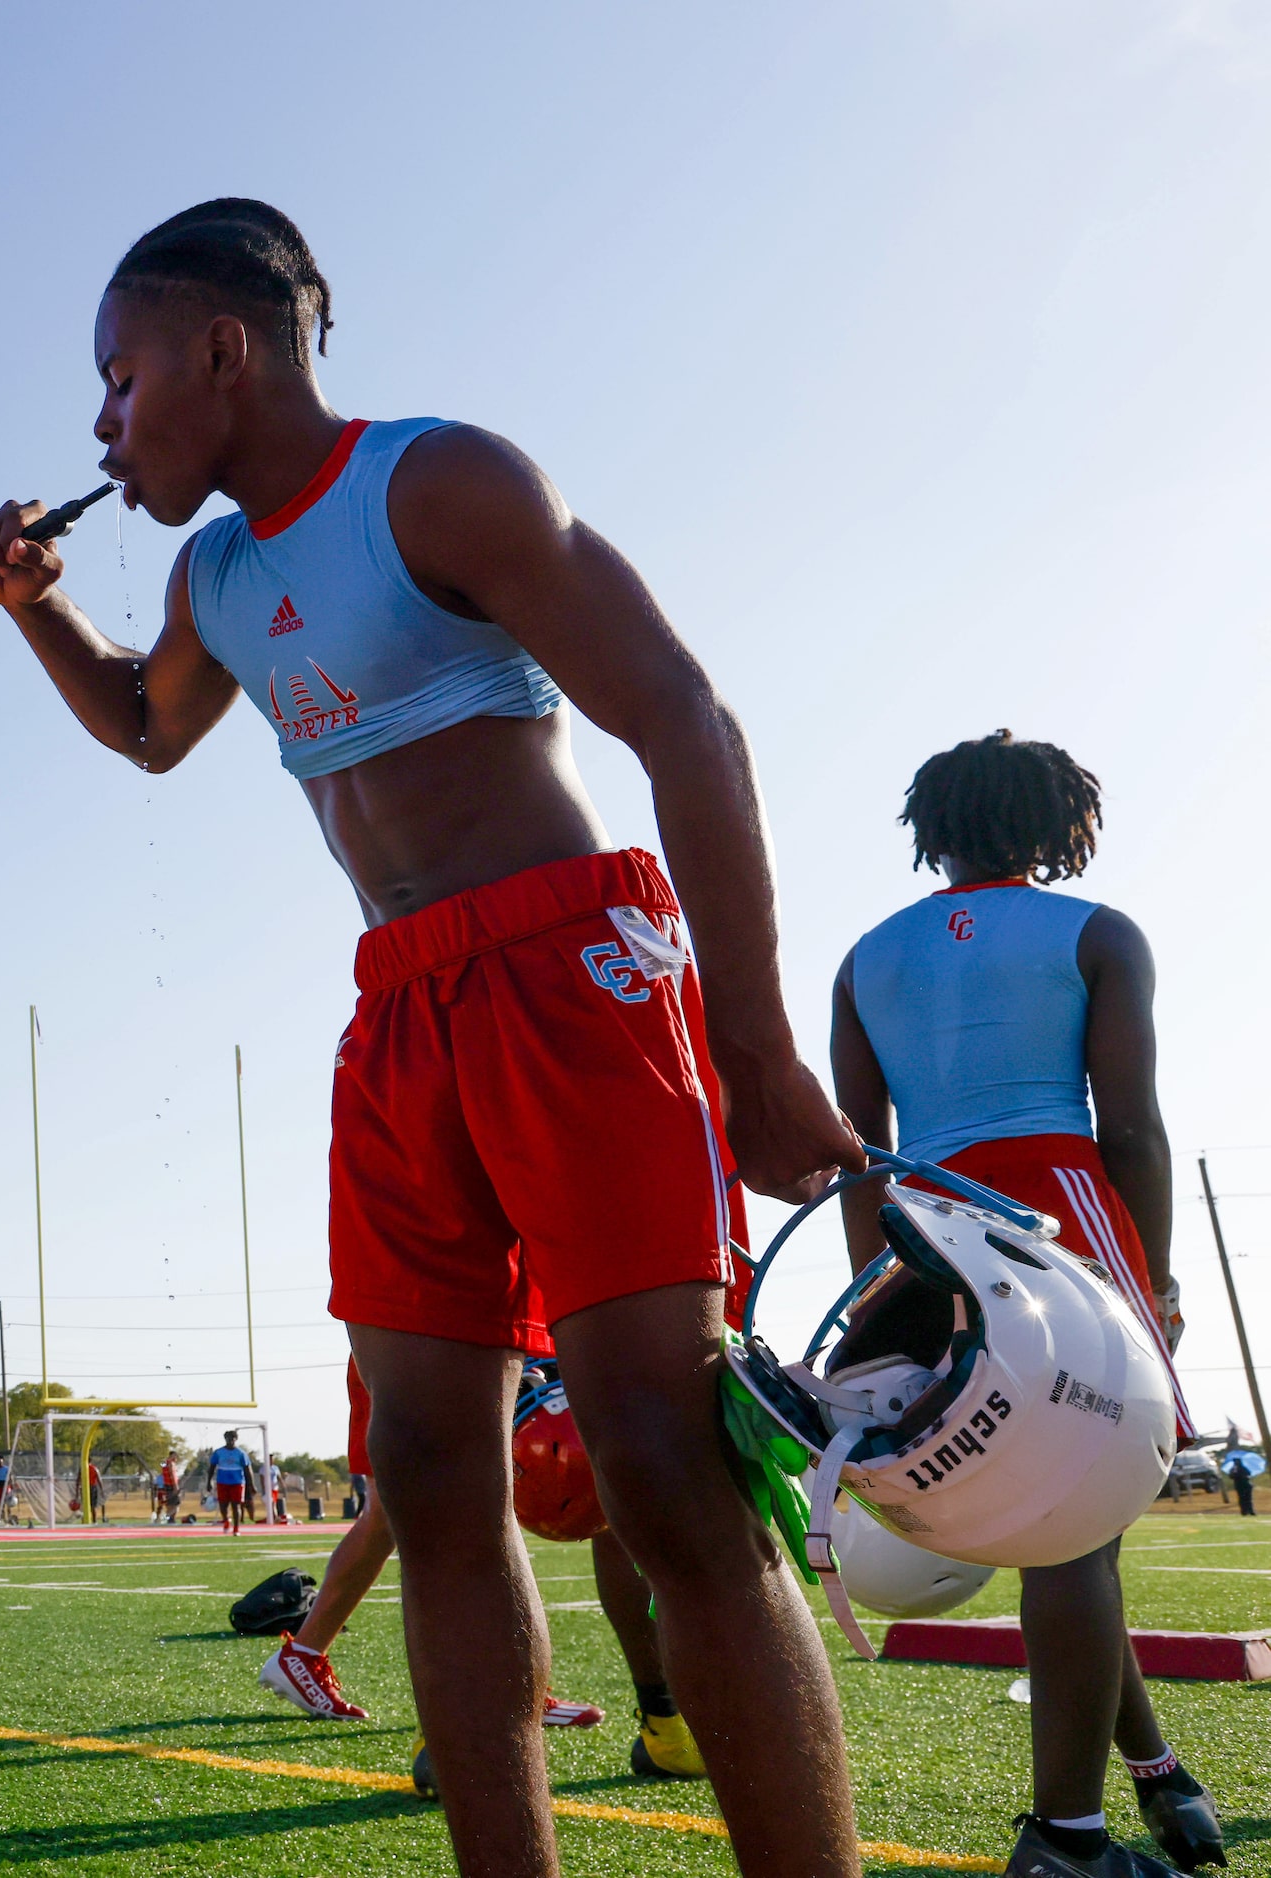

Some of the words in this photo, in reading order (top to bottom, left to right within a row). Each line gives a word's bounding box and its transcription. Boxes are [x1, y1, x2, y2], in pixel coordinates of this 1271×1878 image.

[268, 617, 305, 638] adidas
[281, 705, 360, 743] CARTER
[946, 909, 975, 941] CC
[1049, 1369, 1069, 1405] MEDIUM
[906, 1389, 1013, 1492] schutt
